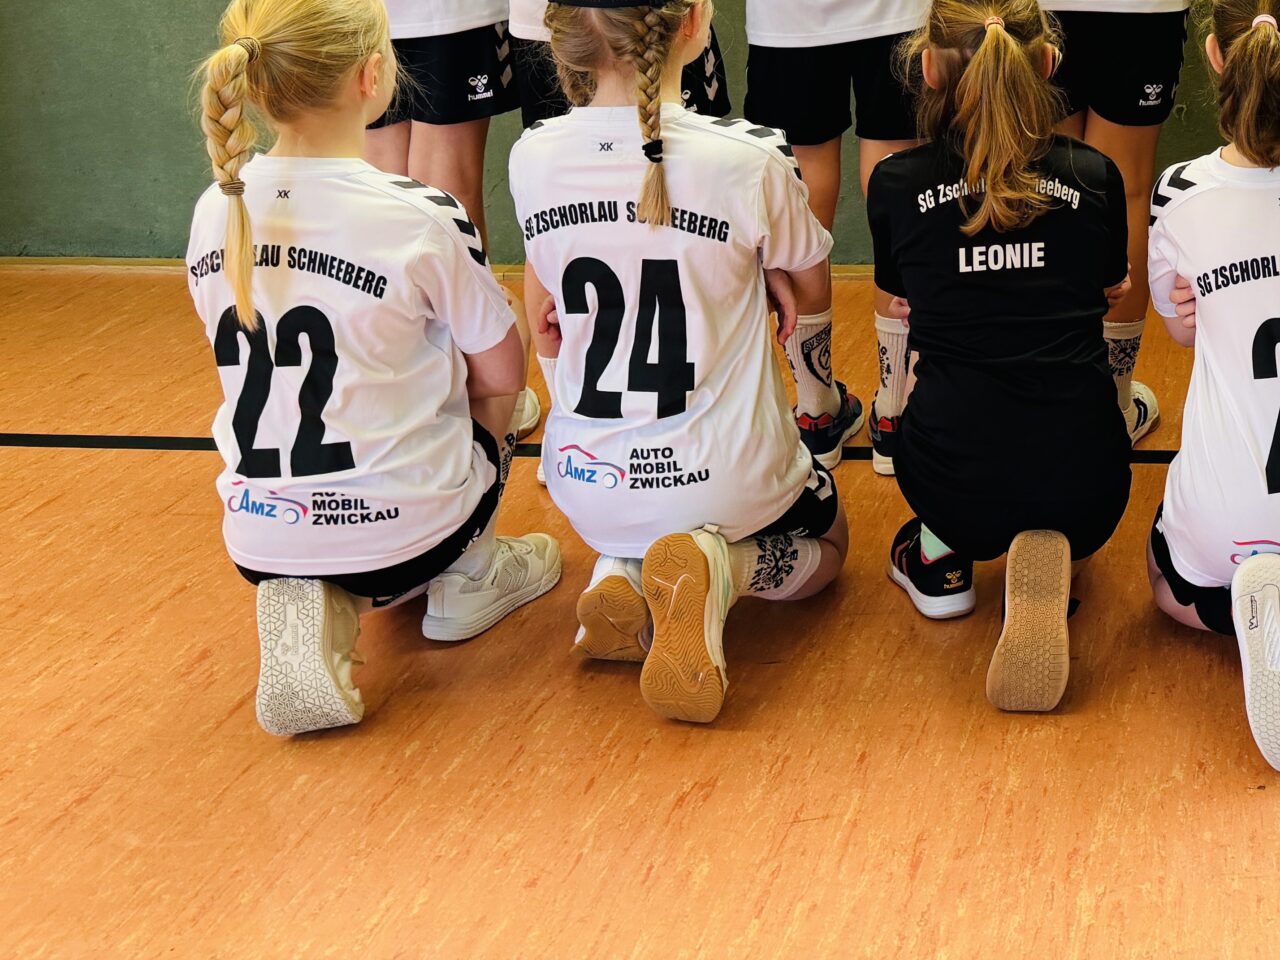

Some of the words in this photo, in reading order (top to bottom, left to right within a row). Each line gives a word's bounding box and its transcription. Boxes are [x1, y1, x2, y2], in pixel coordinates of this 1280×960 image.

[918, 189, 935, 213] SG
[534, 201, 618, 235] ZSCHORLAU
[958, 242, 1045, 273] LEONIE
[287, 246, 388, 299] SCHNEEBERG
[1196, 272, 1213, 297] SG
[562, 257, 695, 419] 24
[214, 304, 356, 478] 22
[629, 447, 673, 460] AUTO
[629, 461, 683, 474] MOBIL
[629, 469, 710, 489] ZWICKAU
[312, 499, 370, 511] MOBIL
[312, 507, 399, 525] ZWICKAU
